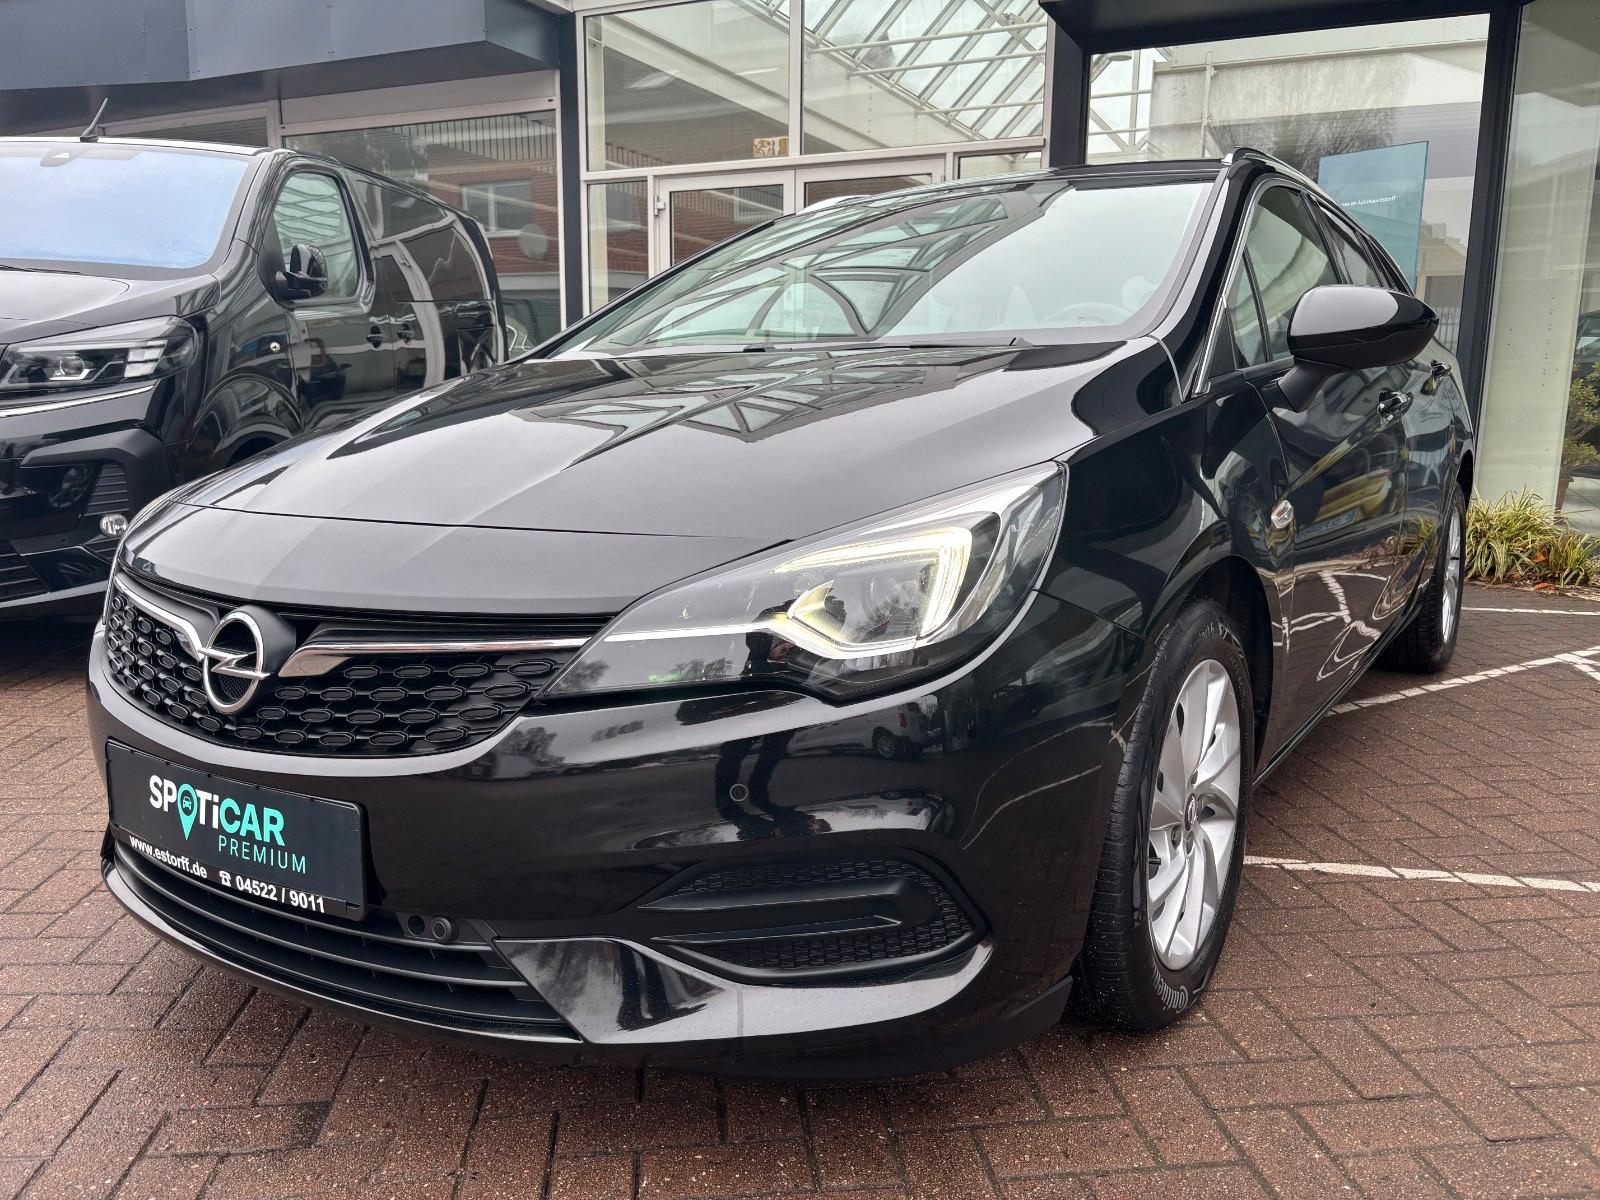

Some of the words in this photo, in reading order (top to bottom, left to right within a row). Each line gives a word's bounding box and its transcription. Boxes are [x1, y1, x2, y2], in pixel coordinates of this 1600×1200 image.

[129, 835, 208, 879] www.estorff.de
[235, 875, 278, 902] 04522
[289, 890, 326, 914] 9011
[218, 834, 307, 875] PREMIUM
